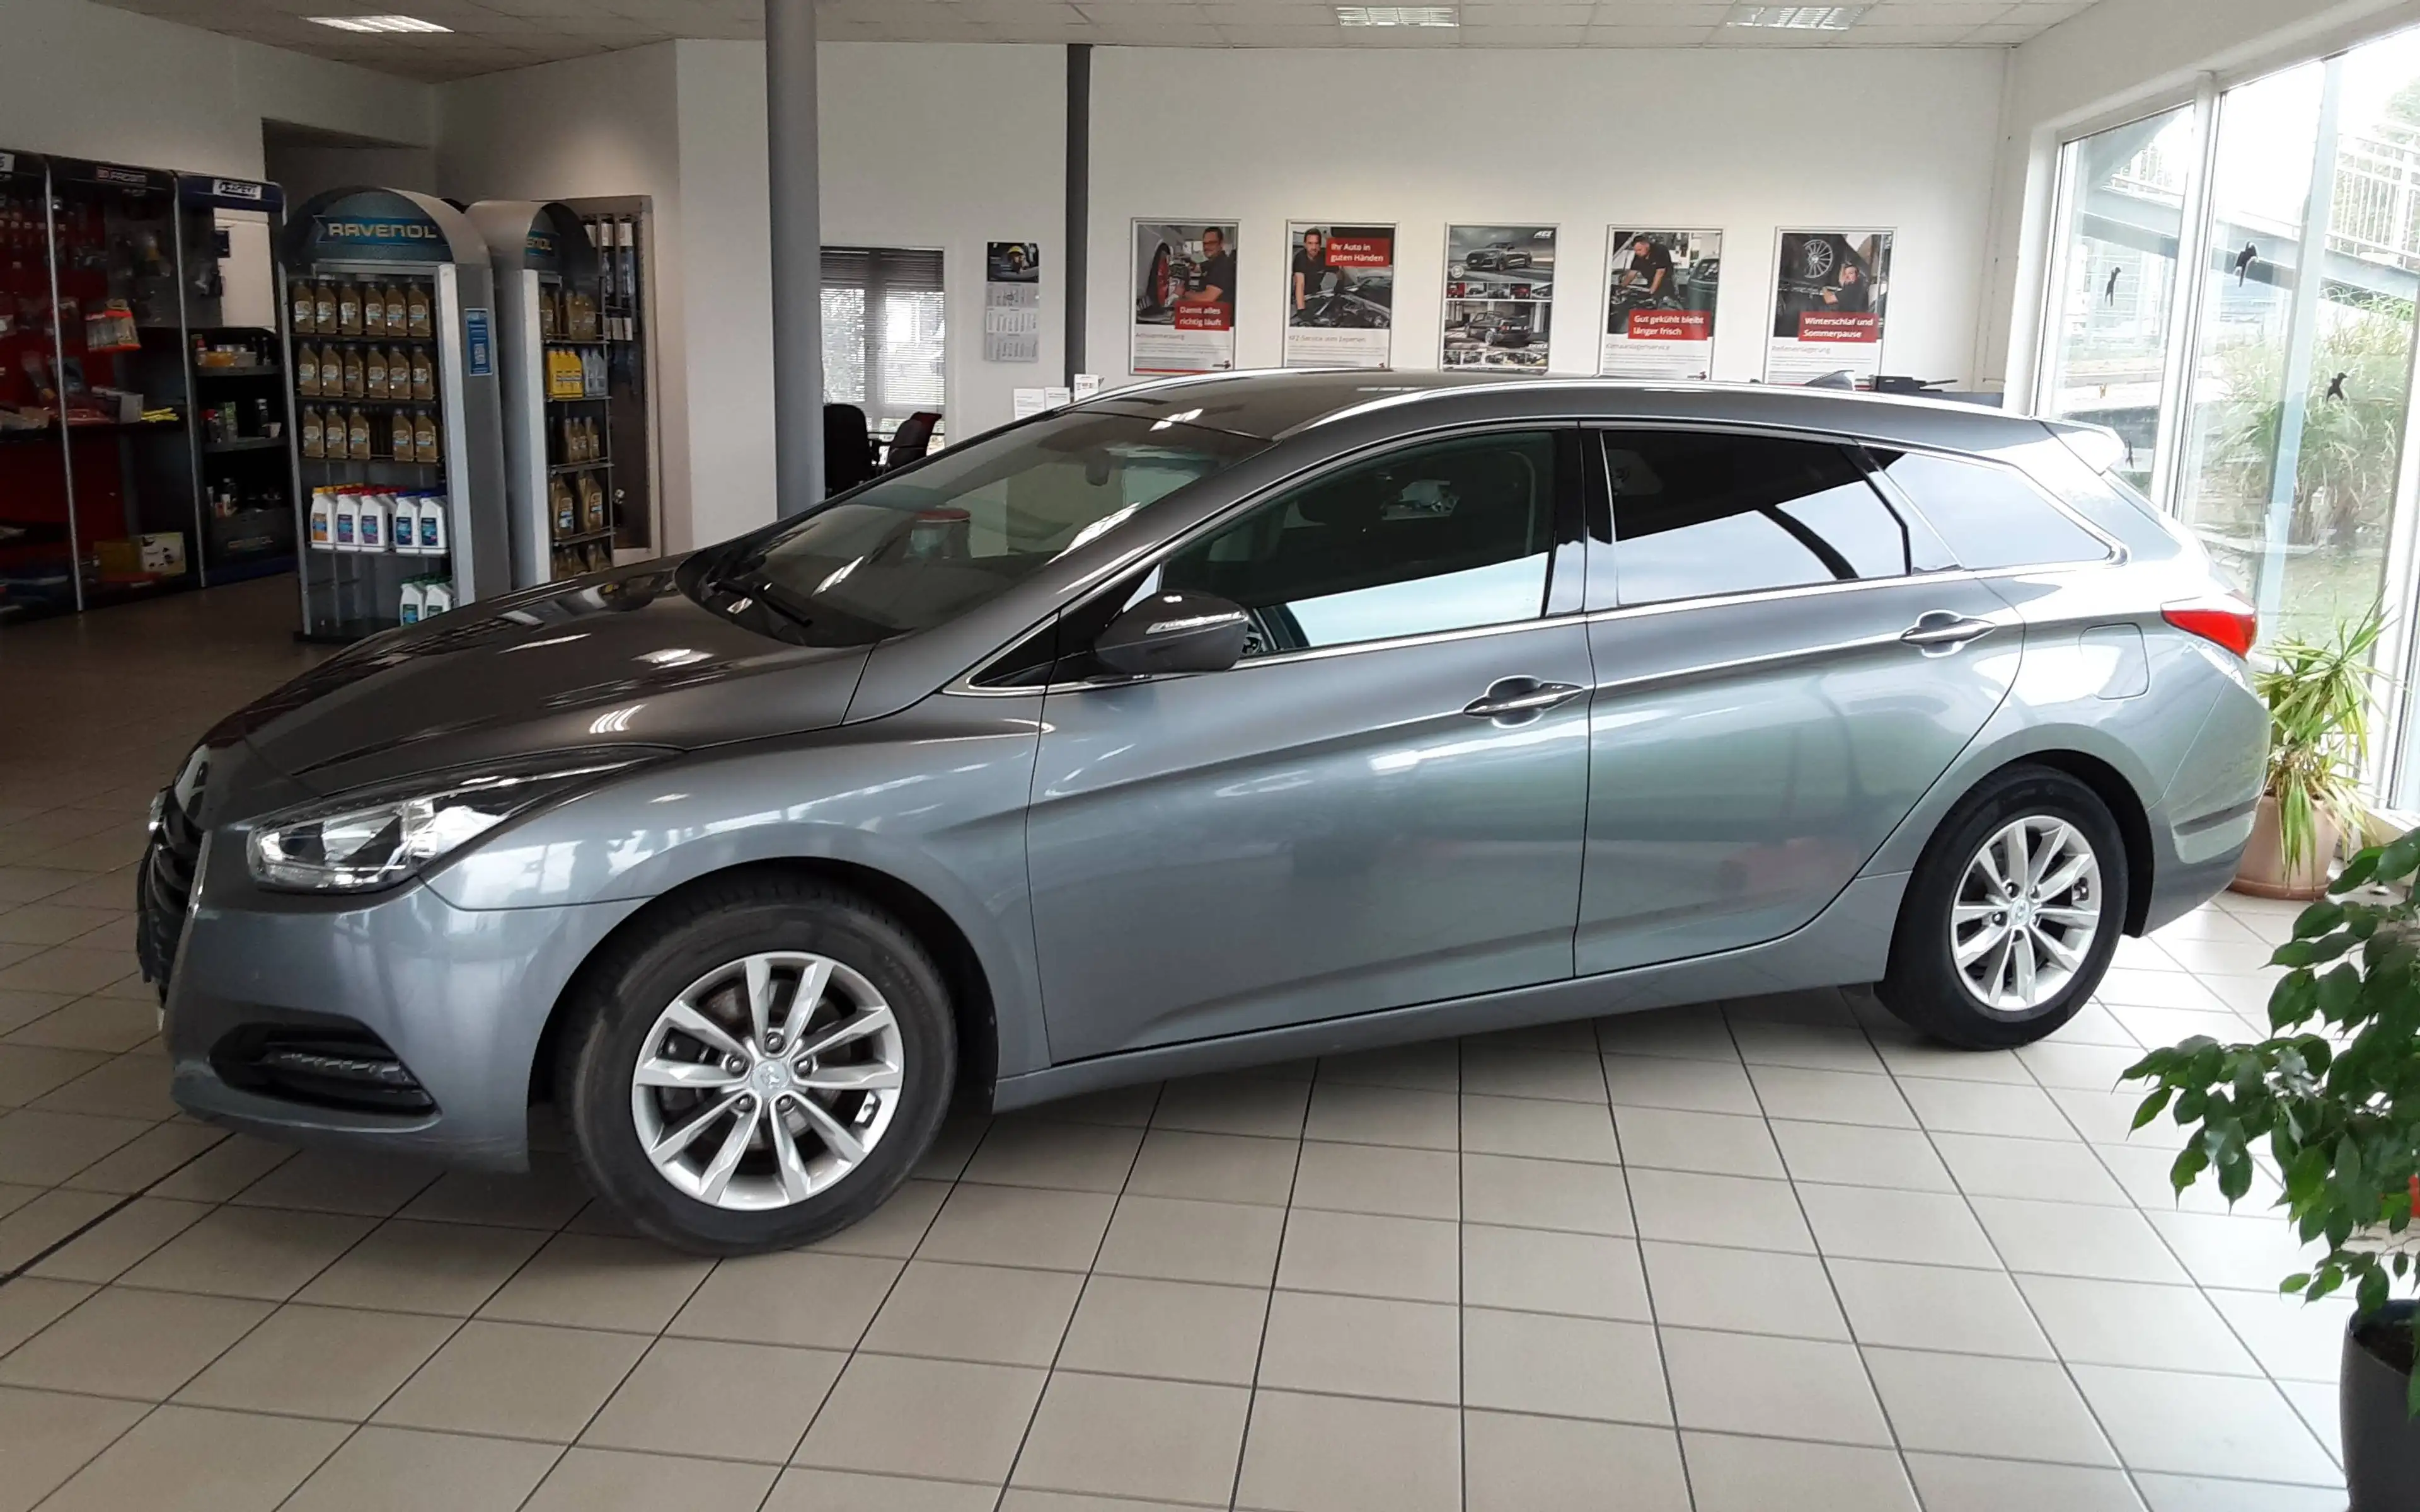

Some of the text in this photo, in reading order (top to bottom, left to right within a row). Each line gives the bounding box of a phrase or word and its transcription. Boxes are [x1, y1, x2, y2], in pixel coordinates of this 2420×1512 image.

[327, 222, 437, 239] RAVENOL
[1330, 254, 1384, 263] guten Händen
[1179, 306, 1221, 314] Damit alles
[1179, 318, 1222, 327] richtig läuft
[1634, 315, 1705, 324] Gut gekühlt bleibt
[1804, 317, 1874, 326] Winterschlaf und
[1659, 327, 1683, 336] frisch
[1802, 328, 1863, 339] Sommerpause
